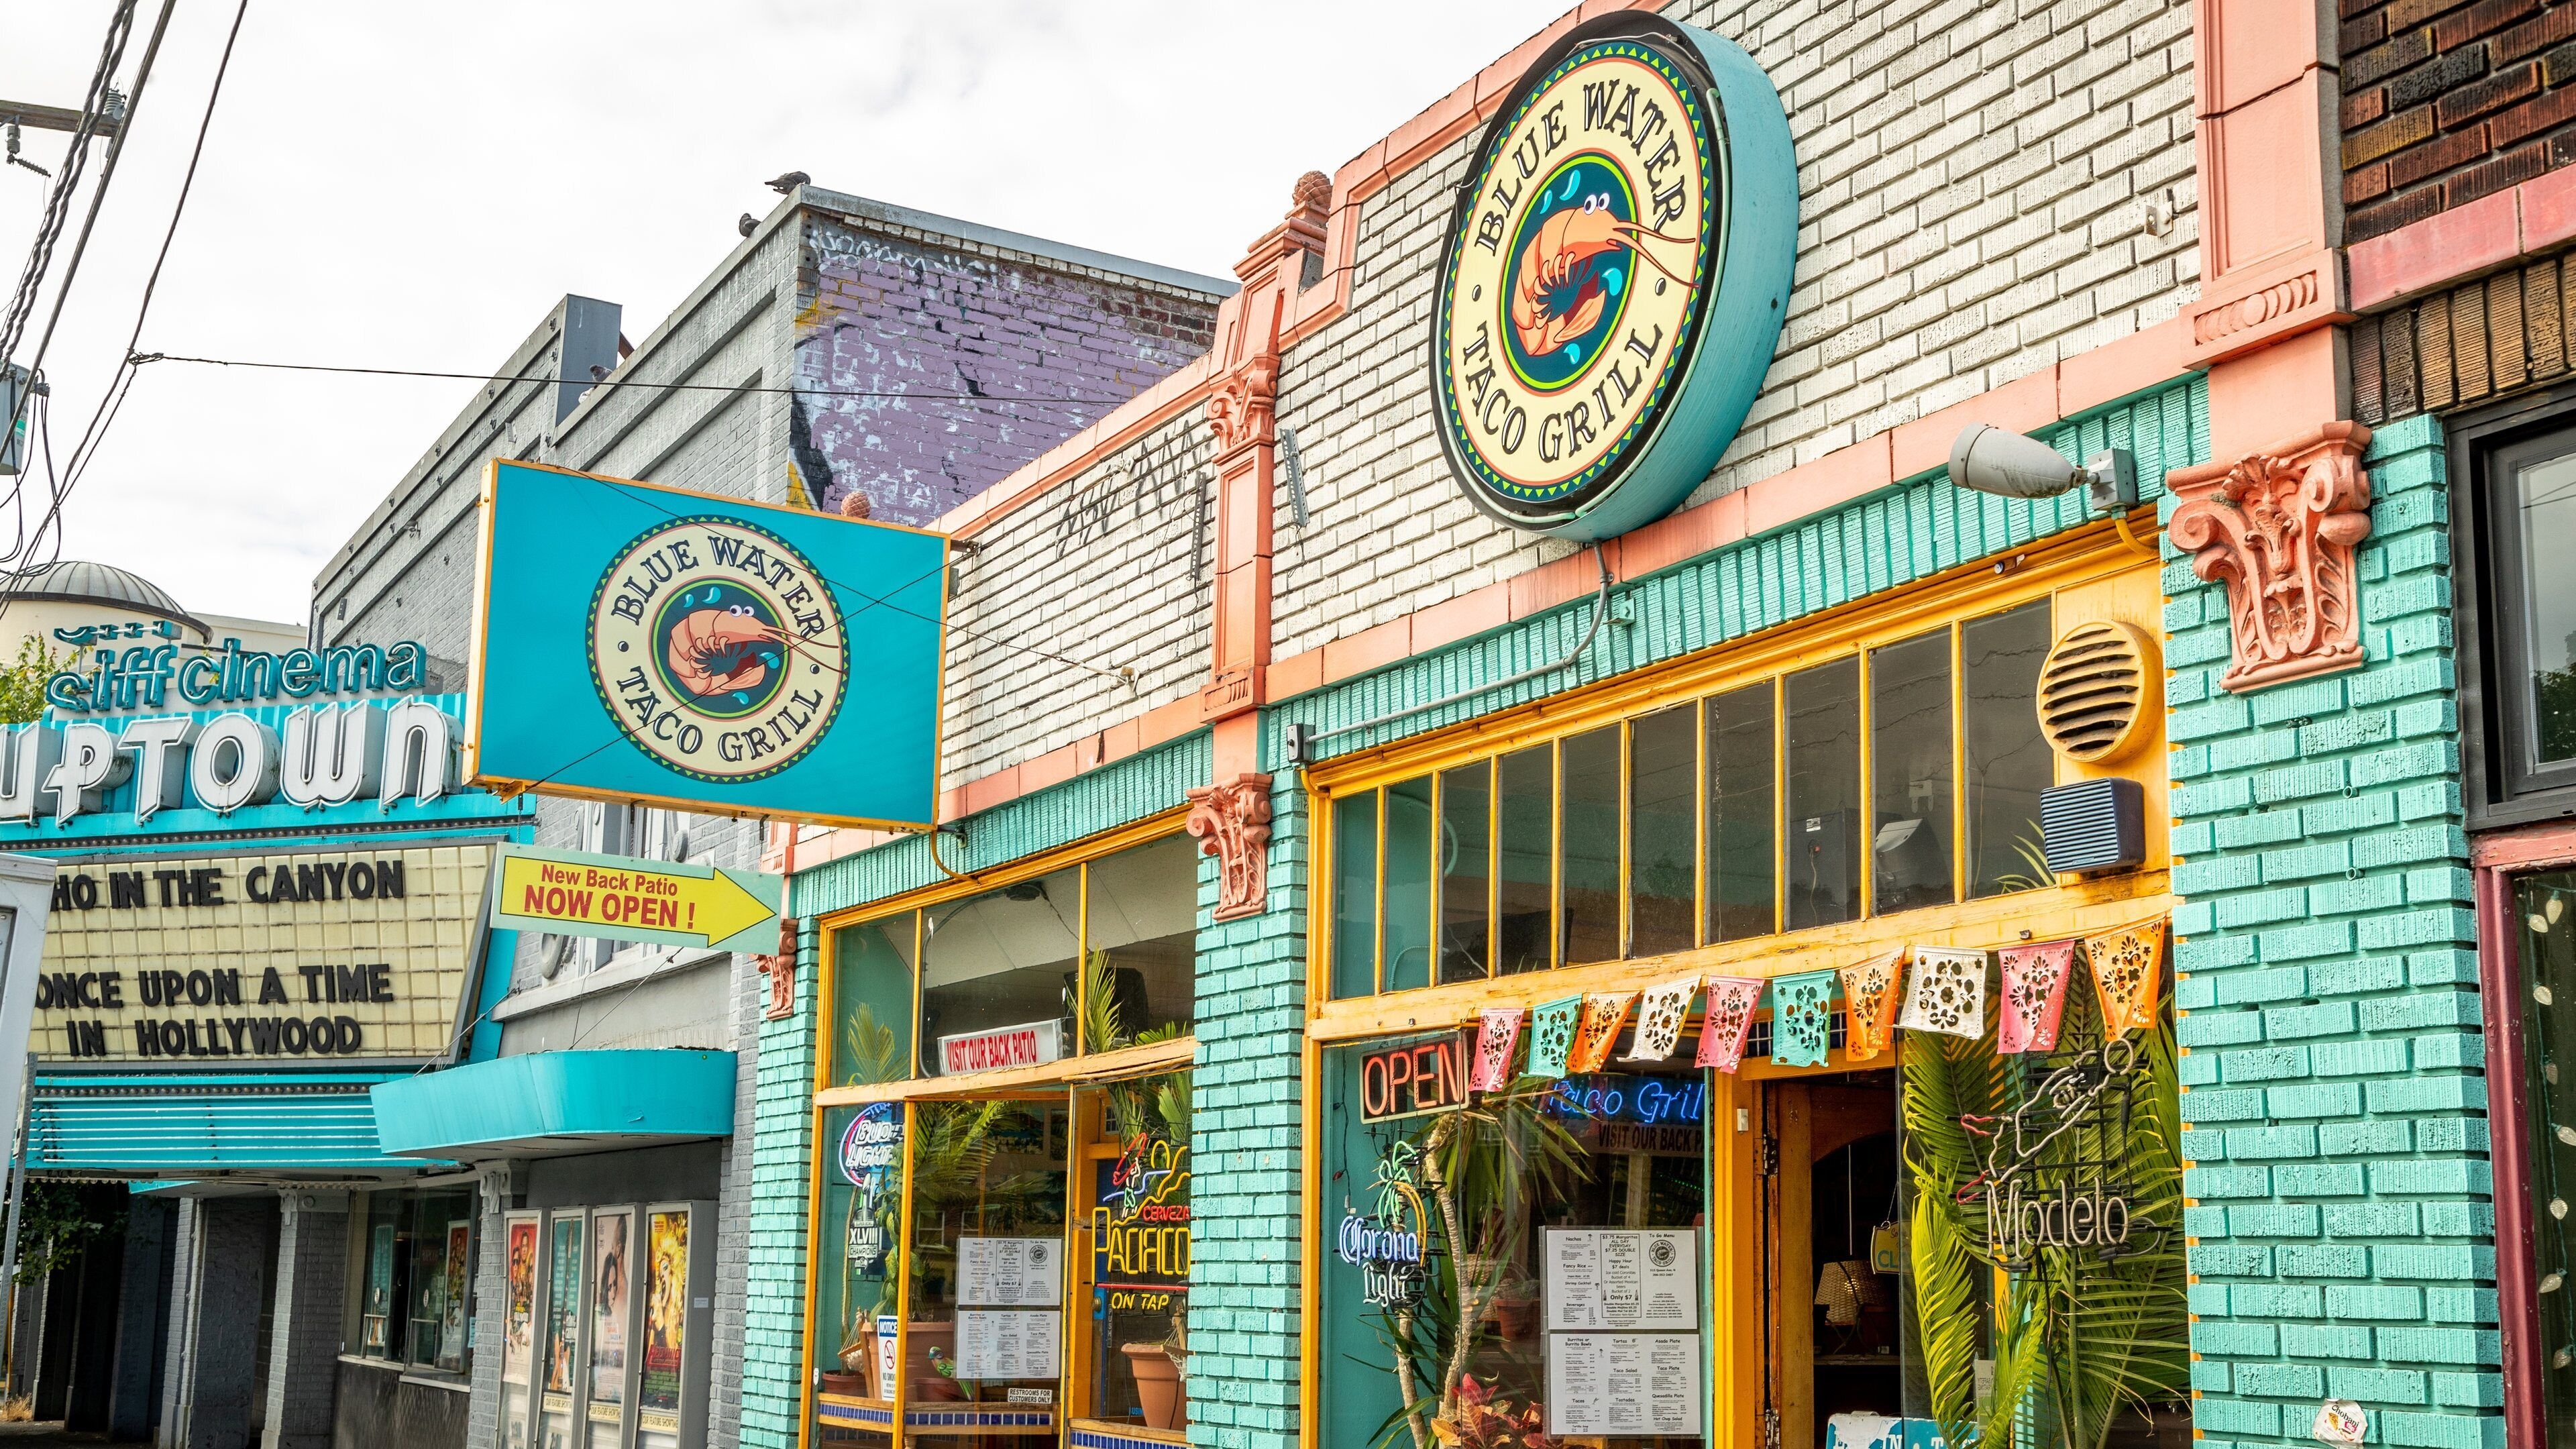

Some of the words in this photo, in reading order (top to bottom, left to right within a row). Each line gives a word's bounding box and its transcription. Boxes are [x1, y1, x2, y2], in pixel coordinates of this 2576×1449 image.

[1475, 99, 1569, 257] BLUE
[1582, 78, 1688, 234] WATER
[1462, 320, 1526, 455] TACO
[1538, 322, 1664, 463] GRILL
[611, 539, 698, 626] BLUE
[708, 535, 826, 639] WATER
[46, 643, 178, 712] siff
[178, 637, 427, 705] cinema
[616, 665, 701, 754] TACO
[719, 688, 824, 761] GRILL
[0, 694, 458, 826] UPTOWN
[110, 871, 144, 910] IN
[153, 868, 223, 908] THE
[246, 860, 404, 905] CANYON
[541, 864, 582, 885] New
[586, 869, 629, 892] Back
[635, 873, 678, 896] Patio
[524, 884, 594, 918] NOW
[602, 893, 678, 928] OPEN
[35, 972, 123, 1010] ONCE
[138, 967, 241, 1008] UPON
[258, 966, 288, 1005] A
[299, 963, 394, 1004] TIME
[67, 1020, 105, 1057] IN
[135, 1016, 362, 1057] HOLLYWOOD
[947, 1040, 967, 1072] VISIT
[969, 1038, 987, 1070] OUR
[988, 1034, 1012, 1068] BACK
[1012, 1030, 1036, 1065] PATIO
[1364, 1040, 1463, 1116] OPEN
[855, 1120, 892, 1144] BUD
[1599, 1124, 1629, 1148] VISIT
[1631, 1126, 1657, 1150] OUR
[1660, 1128, 1692, 1151] BACK
[849, 1228, 877, 1244] XLVIII
[1142, 1205, 1190, 1222] CERVEZA
[1984, 1176, 2129, 1260] Modelo
[850, 1247, 877, 1255] CHAMPIONS
[1091, 1207, 1191, 1286] PACIFICO
[1339, 1216, 1419, 1267] Corona
[1112, 1292, 1136, 1310] ON
[1141, 1293, 1169, 1310] TAP
[880, 1321, 897, 1334] NOTICE
[2331, 1404, 2360, 1428] Chobani
